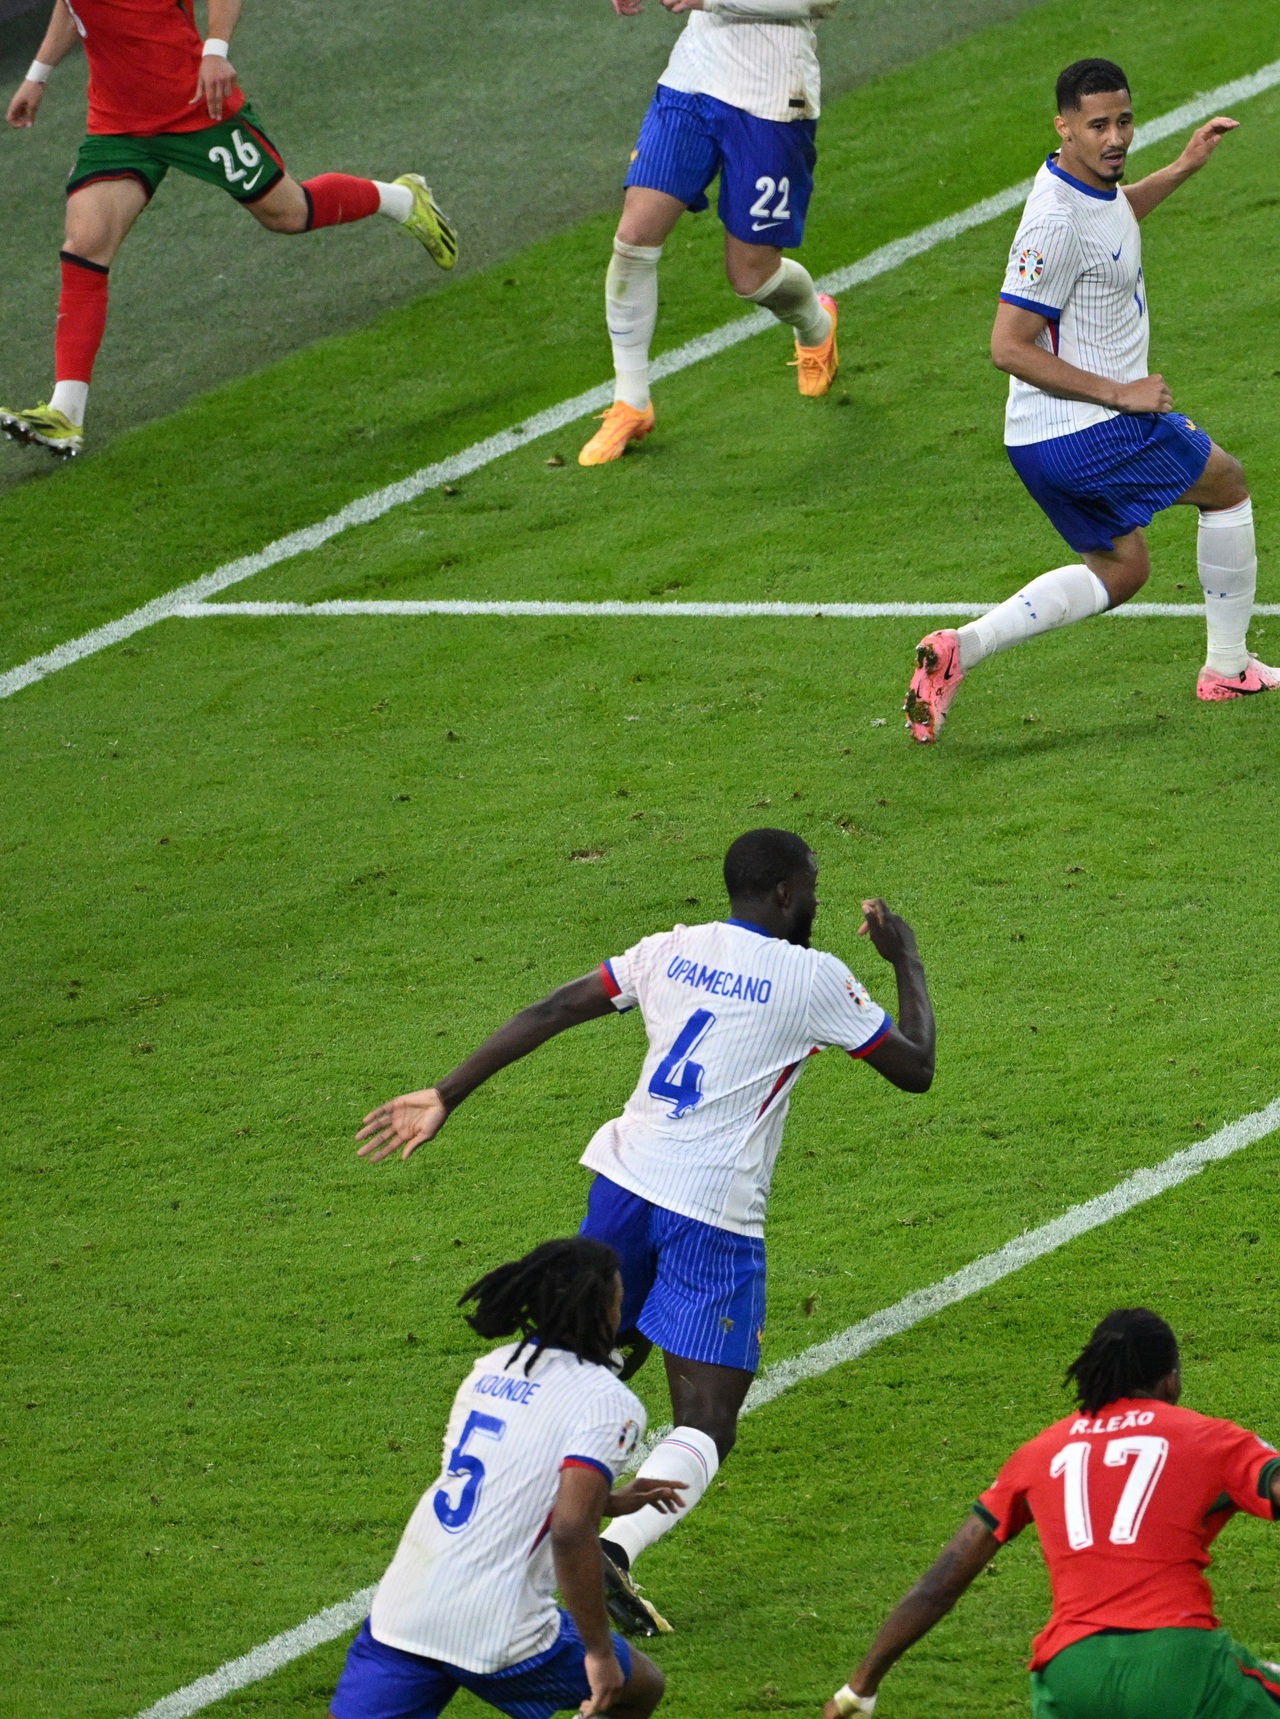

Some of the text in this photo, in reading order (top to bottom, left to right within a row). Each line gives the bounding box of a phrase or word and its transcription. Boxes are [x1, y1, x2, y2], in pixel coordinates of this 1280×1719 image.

[208, 129, 261, 183] 26
[749, 175, 791, 219] 22
[667, 955, 772, 1004] UPAMECANO
[648, 1007, 716, 1120] 4
[473, 1374, 541, 1405] KOUNDE
[1069, 1409, 1155, 1436] R.LEÃO
[433, 1409, 507, 1534] 5
[1050, 1435, 1169, 1550] 17
